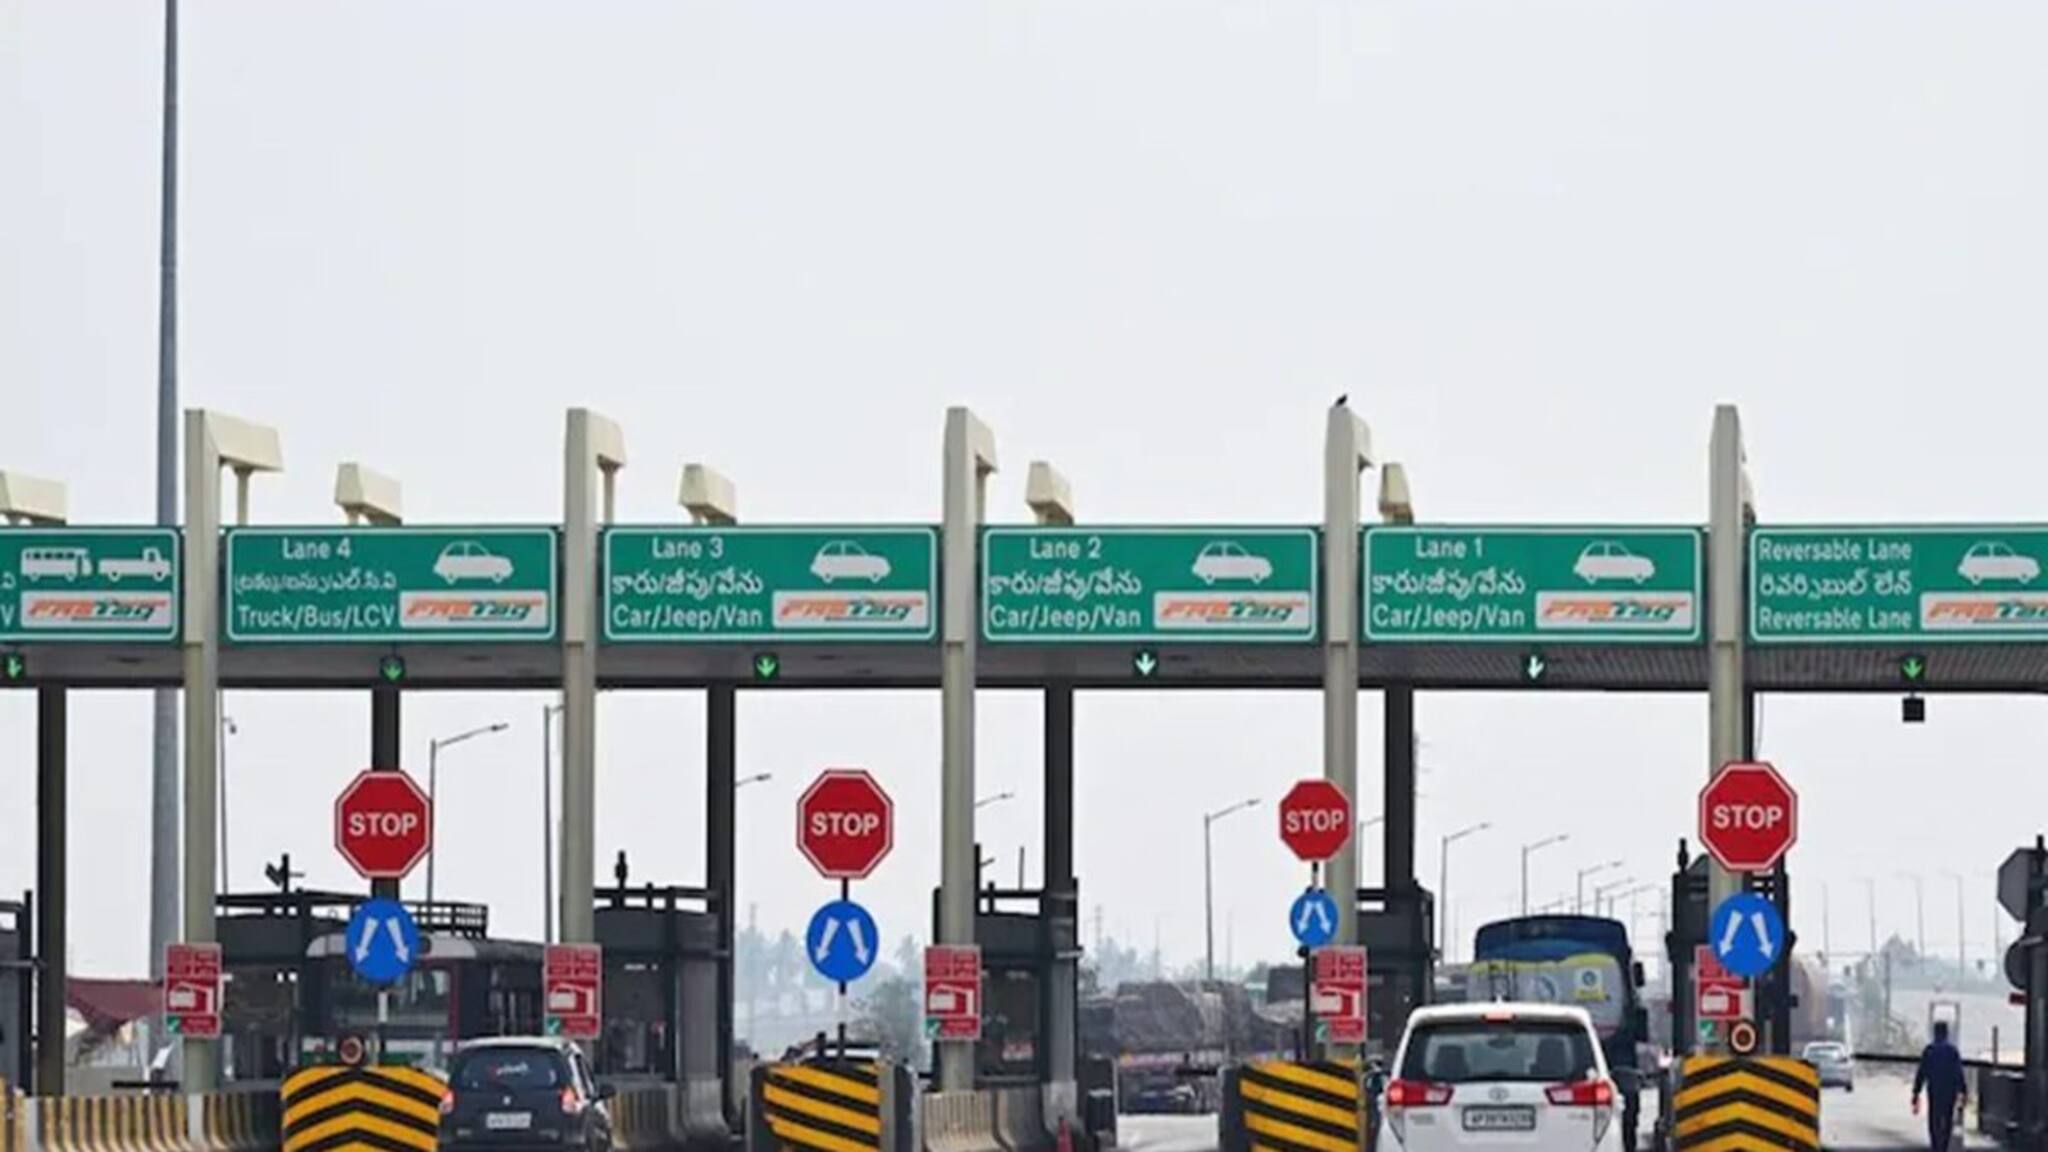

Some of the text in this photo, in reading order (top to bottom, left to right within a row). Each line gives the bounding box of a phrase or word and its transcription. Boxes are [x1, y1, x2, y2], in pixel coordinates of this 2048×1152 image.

[282, 536, 352, 560] Lane 4
[652, 536, 724, 559] Lane 3
[1030, 536, 1102, 559] Lane 2
[1415, 536, 1483, 558] Lane 1
[1759, 538, 1912, 561] Reversable Lane
[237, 604, 396, 629] Truck/Bus/LCV
[612, 603, 763, 630] Car/Jeep/Van
[990, 603, 1142, 630] Car/Jeep/Van
[1372, 603, 1526, 629] Car/Jeep/Van
[1759, 606, 1912, 629] Reversable Lane
[348, 811, 419, 836] STOP
[811, 812, 880, 836] STOP
[1286, 810, 1345, 832] STOP
[1713, 804, 1783, 830] STOP
